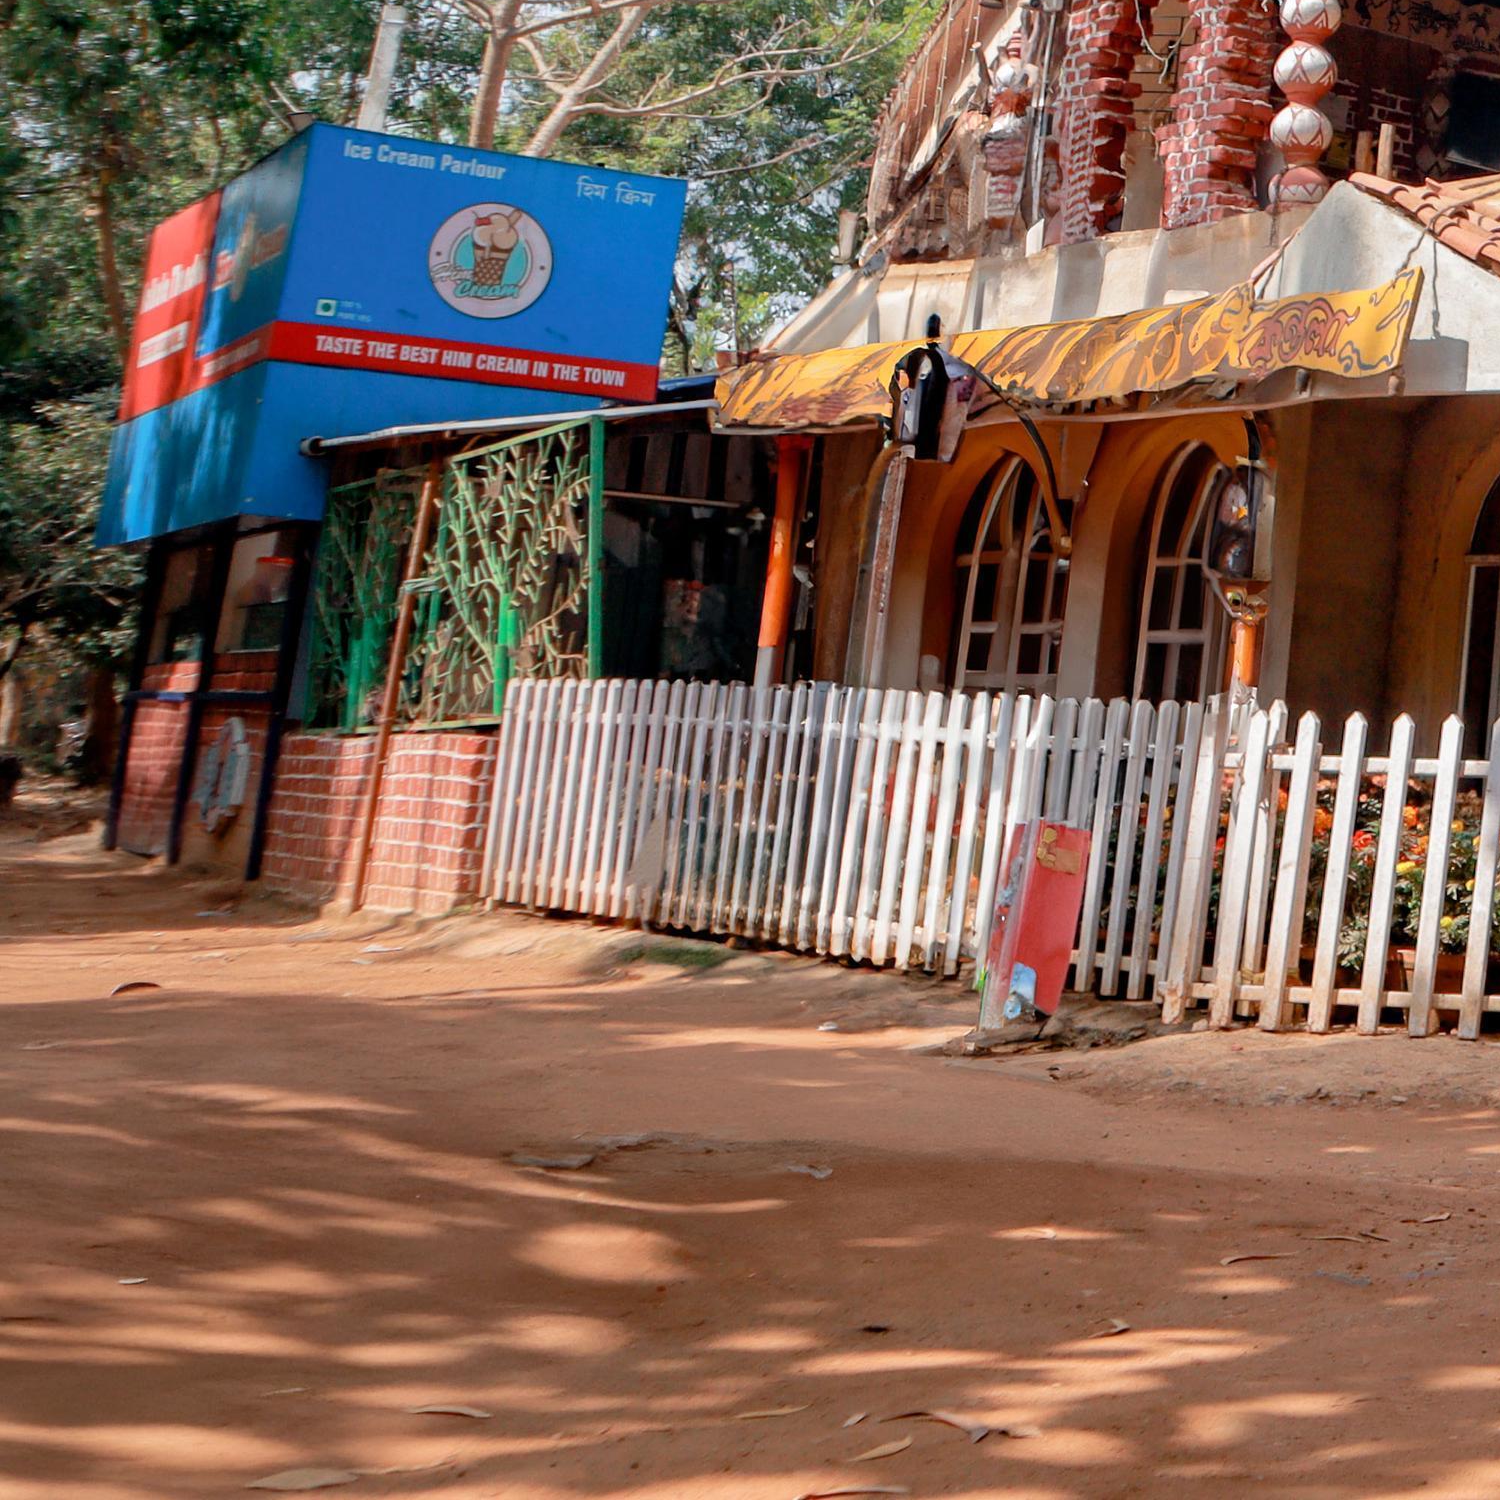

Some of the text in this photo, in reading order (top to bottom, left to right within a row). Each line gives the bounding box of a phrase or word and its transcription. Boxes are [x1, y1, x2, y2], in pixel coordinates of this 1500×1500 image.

[344, 139, 506, 180] Ice Cream Parlour
[315, 335, 626, 387] TASTE THE BEST HIM CREAM IN THE TOWN
